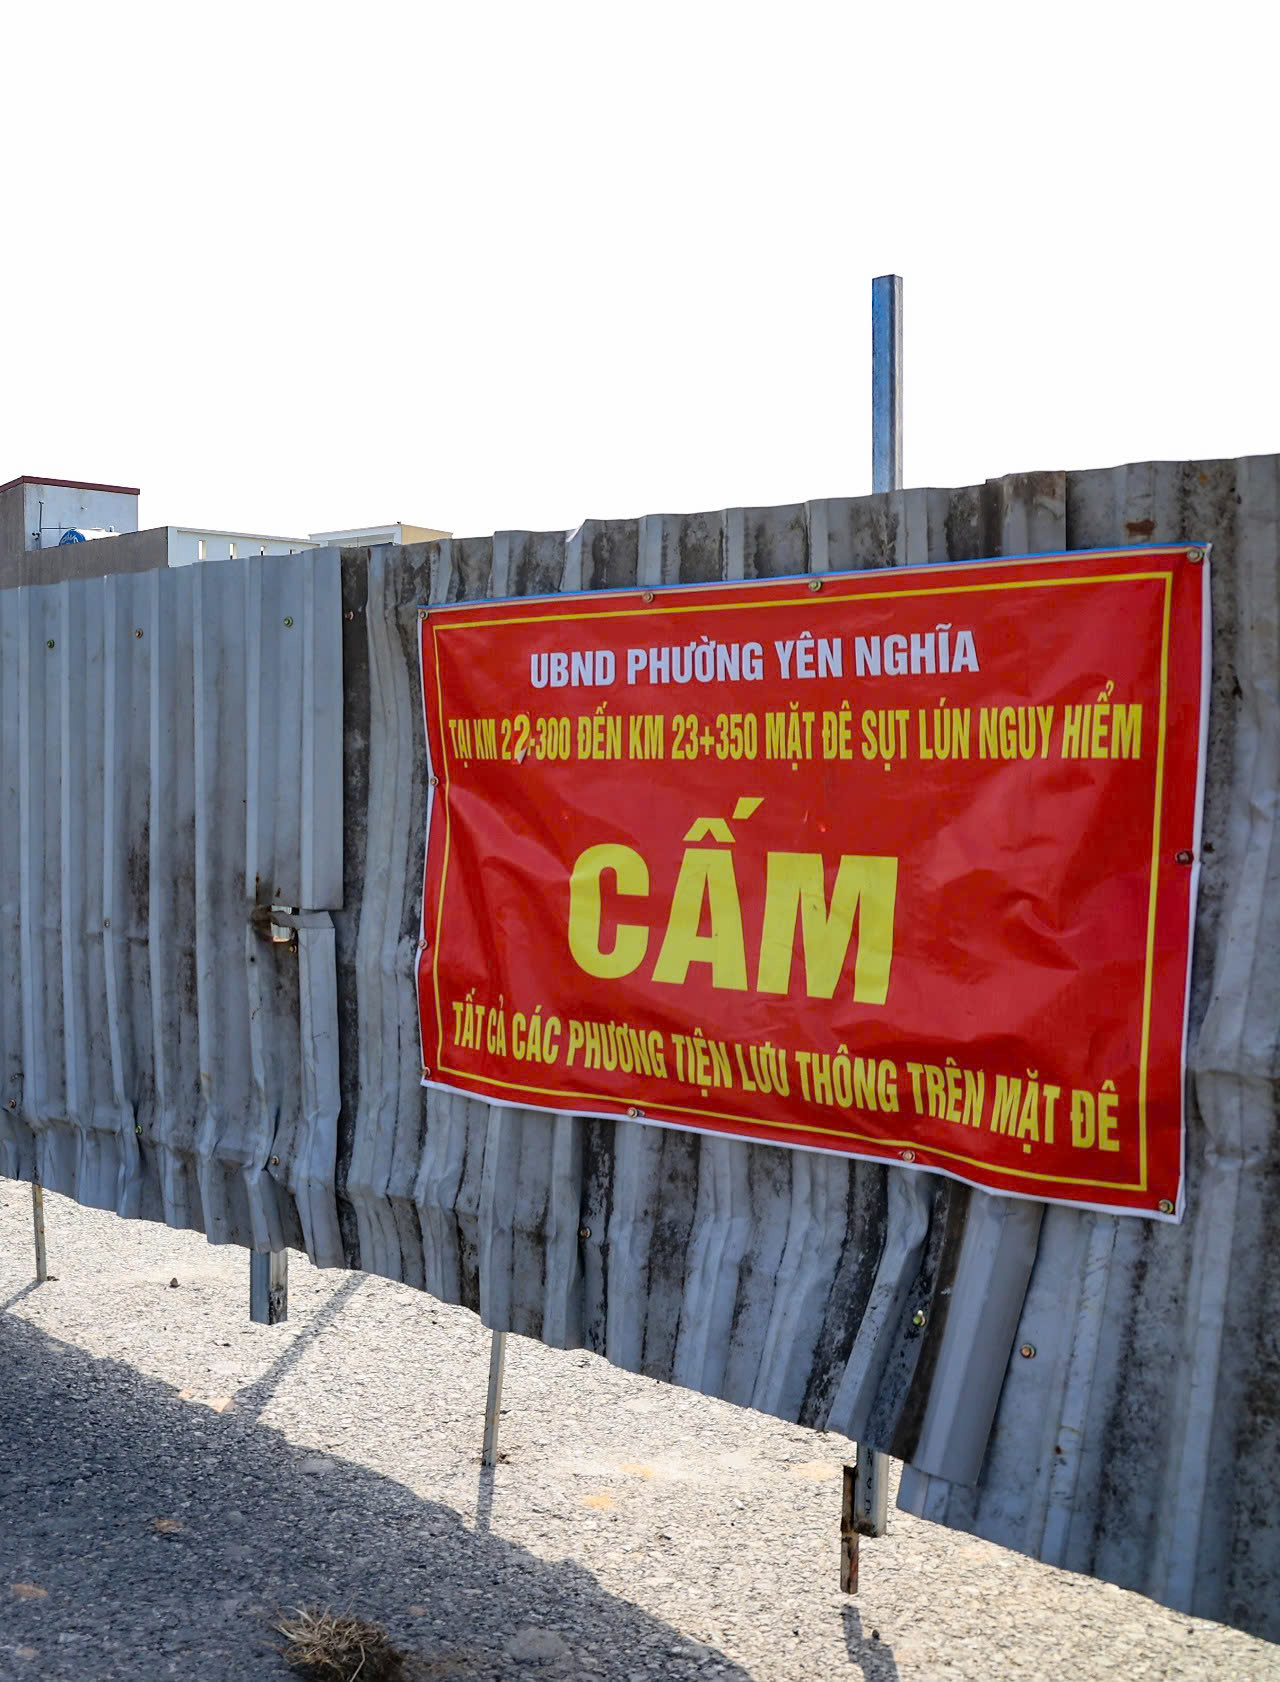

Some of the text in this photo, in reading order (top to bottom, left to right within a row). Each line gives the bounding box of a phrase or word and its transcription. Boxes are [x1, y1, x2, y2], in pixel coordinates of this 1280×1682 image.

[530, 623, 980, 688] UBND PHƯỜNG YÊN NGHĨA
[448, 719, 473, 768] TẠI
[473, 719, 498, 760] KM
[577, 701, 622, 760] ĐẾN
[629, 715, 664, 760] KM
[671, 713, 758, 760] 23+350
[765, 701, 815, 771] MẶT
[822, 700, 853, 760] ĐÊ
[861, 709, 910, 772] SỤT
[918, 697, 970, 760] LÚN
[979, 705, 1054, 760] NGUY
[1061, 679, 1142, 760] HIỂM
[568, 796, 899, 1006] CẤM
[452, 987, 1120, 1154] TẤT CẢ CÁC PHƯƠNG TIỆN LƯU THÔNG TRÊN MẶT ĐÊ
